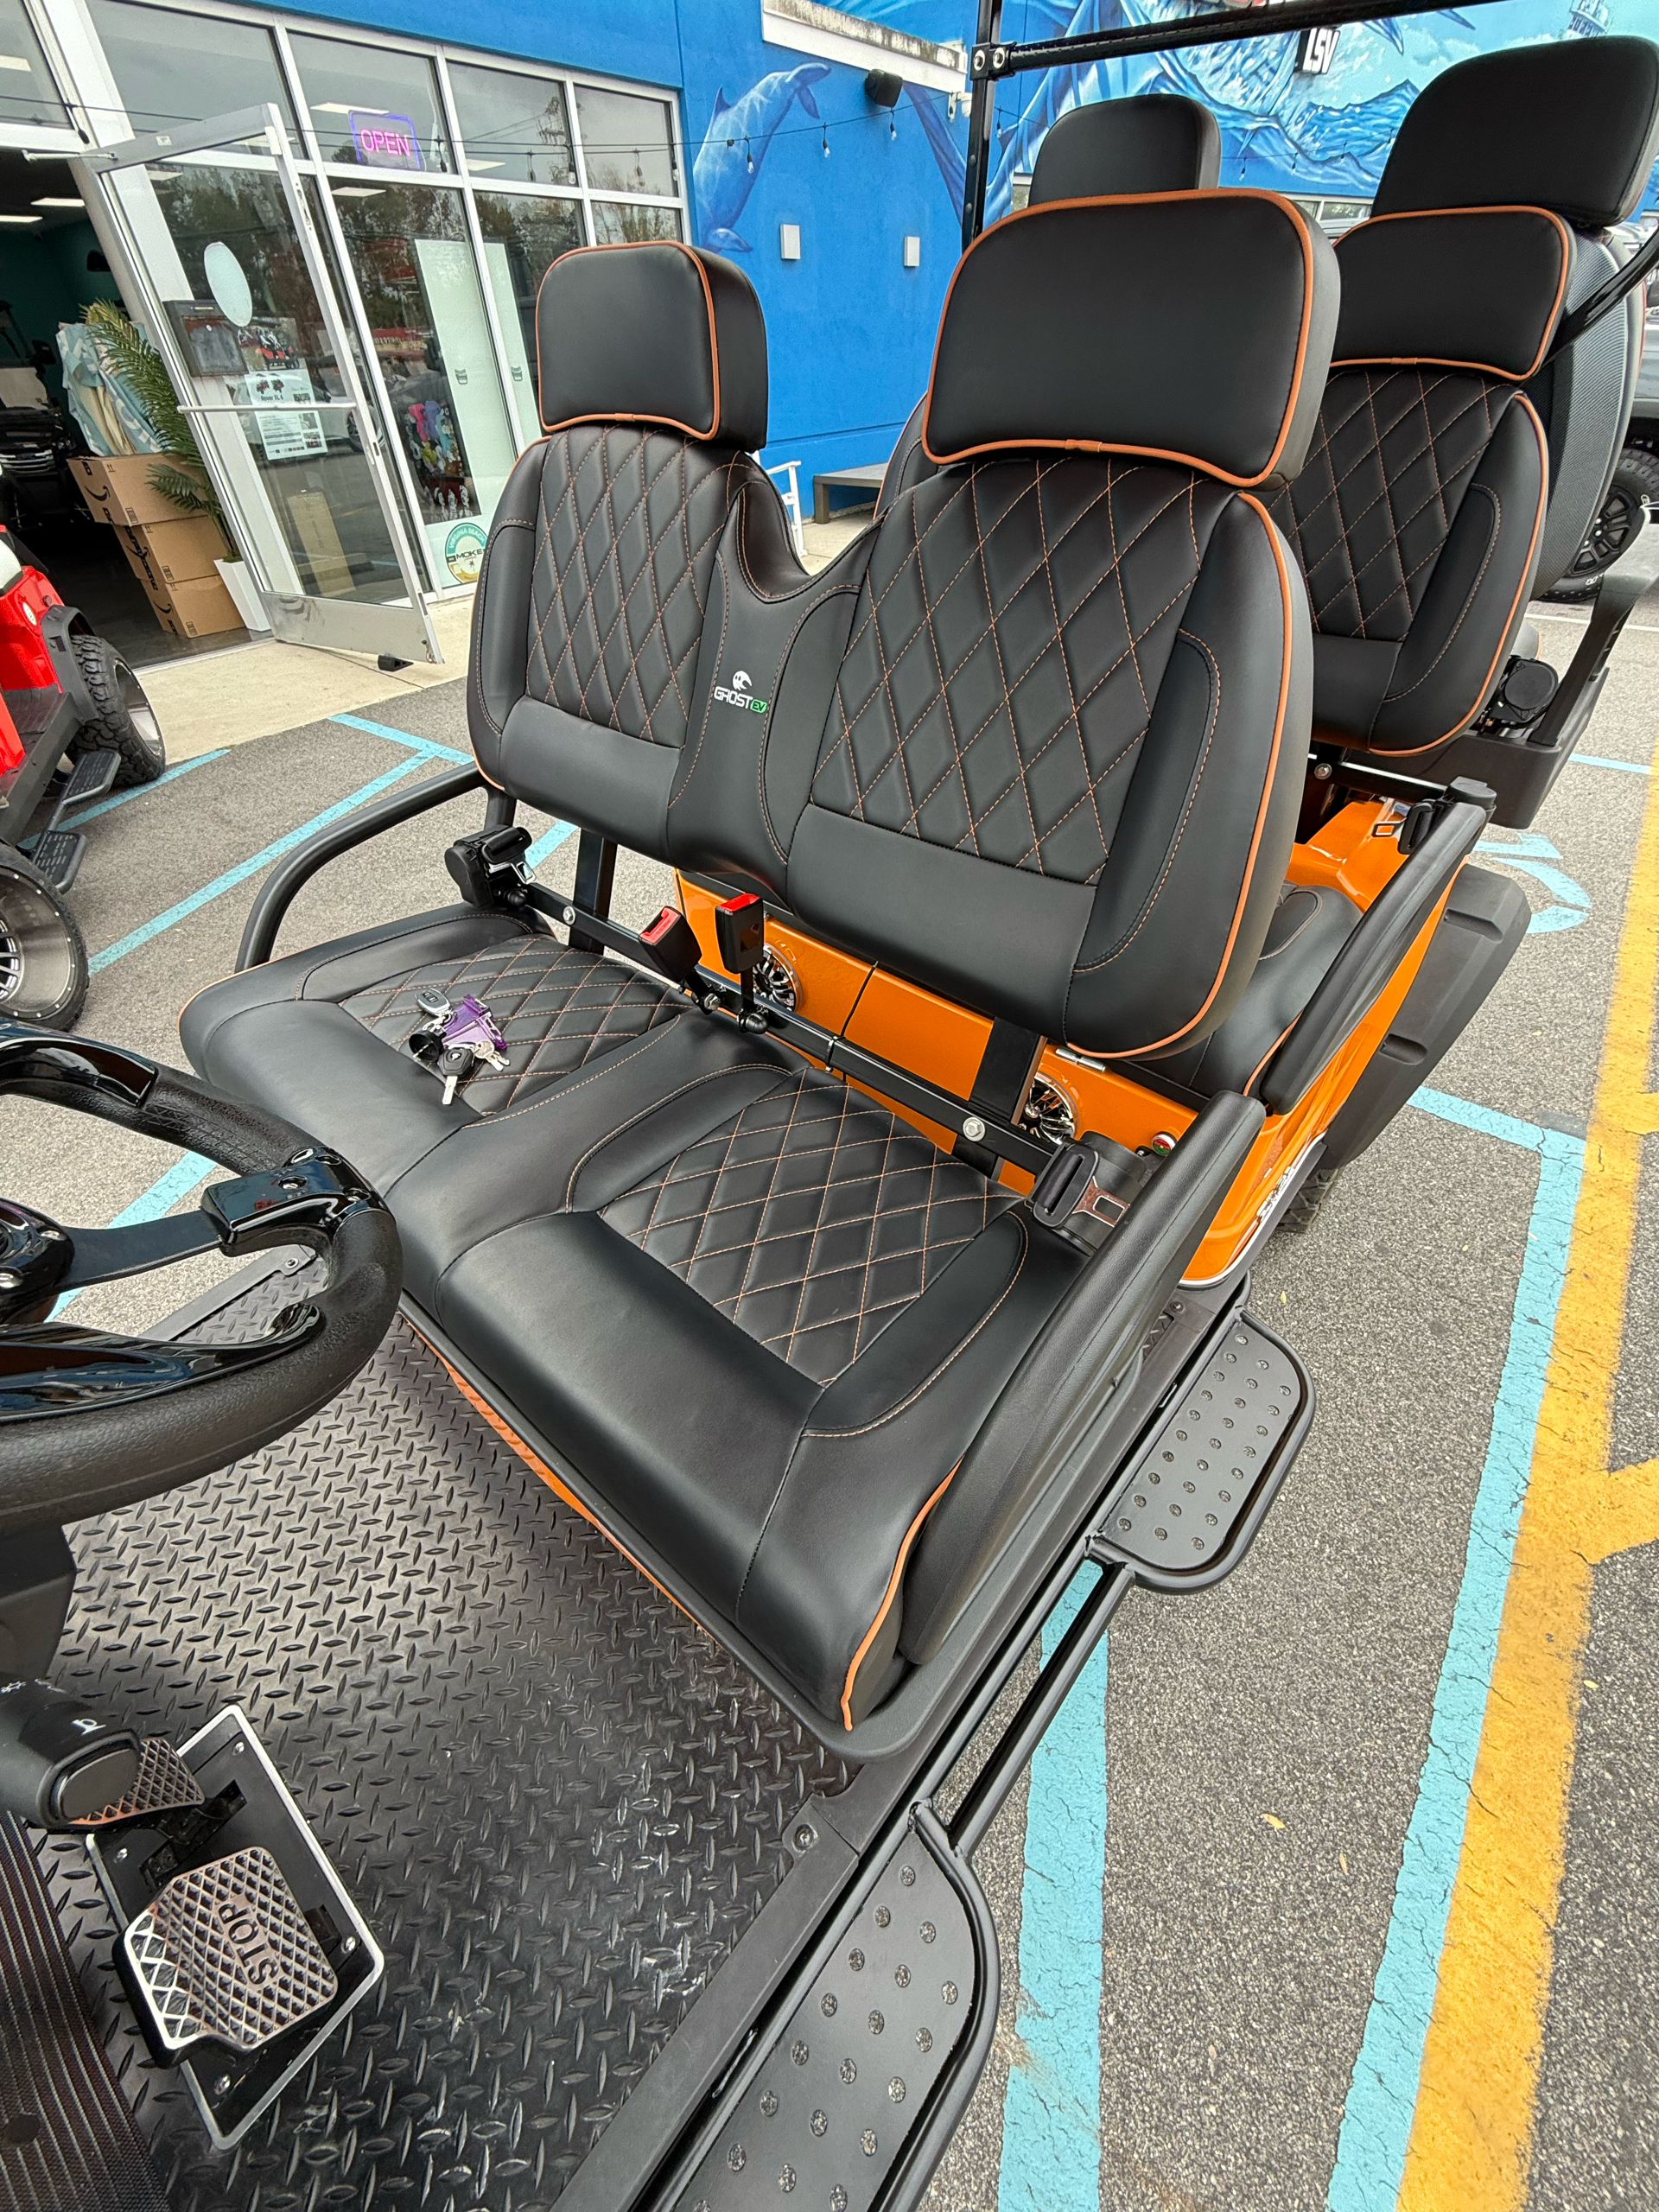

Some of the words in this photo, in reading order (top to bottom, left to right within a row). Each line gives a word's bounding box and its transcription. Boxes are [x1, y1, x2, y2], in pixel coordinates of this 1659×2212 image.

[1302, 27, 1340, 73] LSV
[360, 129, 410, 156] OPEN
[448, 527, 468, 549] VIRGINIA
[467, 527, 486, 543] BEACH
[455, 548, 483, 560] MOKE
[714, 685, 753, 709] GHOST
[751, 699, 766, 713] EV
[218, 1903, 279, 1985] STOP
